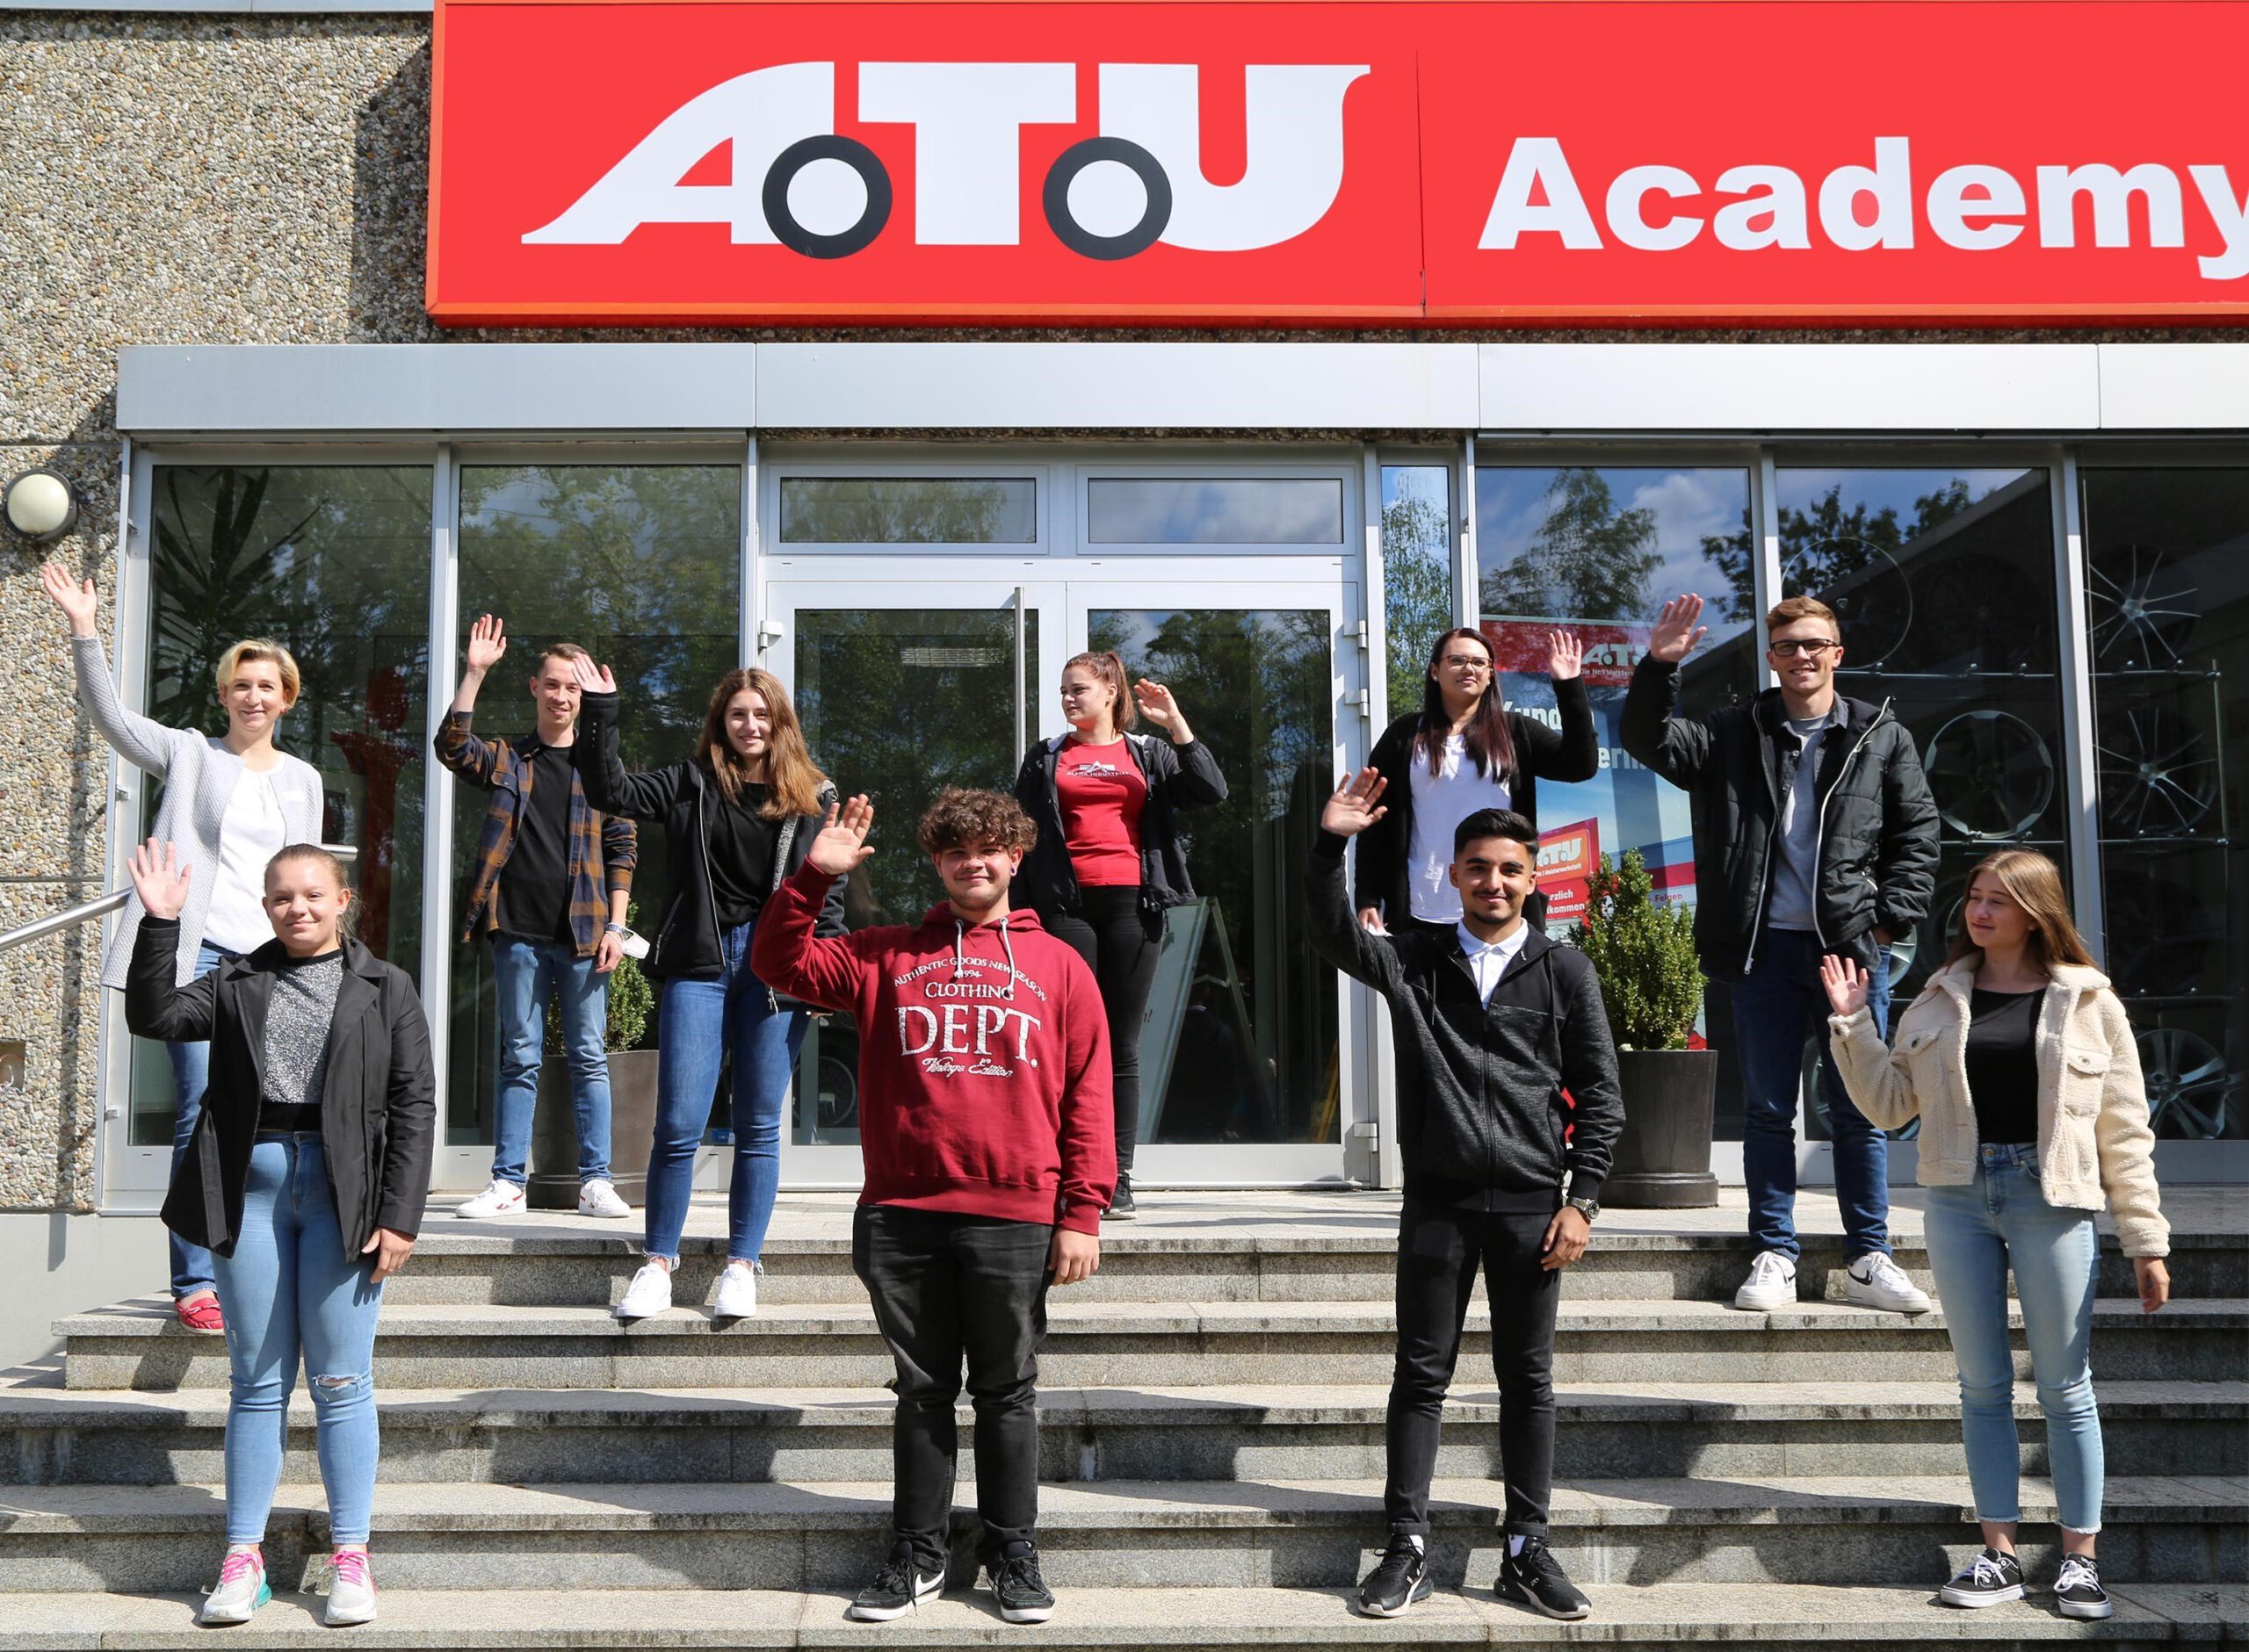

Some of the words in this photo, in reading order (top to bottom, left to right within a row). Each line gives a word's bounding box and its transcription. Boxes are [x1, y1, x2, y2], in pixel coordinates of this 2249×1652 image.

[1477, 136, 2249, 280] Academy
[1546, 903, 1585, 914] lkommen
[1550, 889, 1574, 901] rzlich
[894, 958, 949, 987] AUTHENTIC
[950, 956, 988, 967] GOODS
[1015, 970, 1047, 1002] SEASON
[895, 1003, 1042, 1068] DEPT.
[922, 1056, 965, 1078] Vintage
[968, 1057, 1014, 1078] Edition
